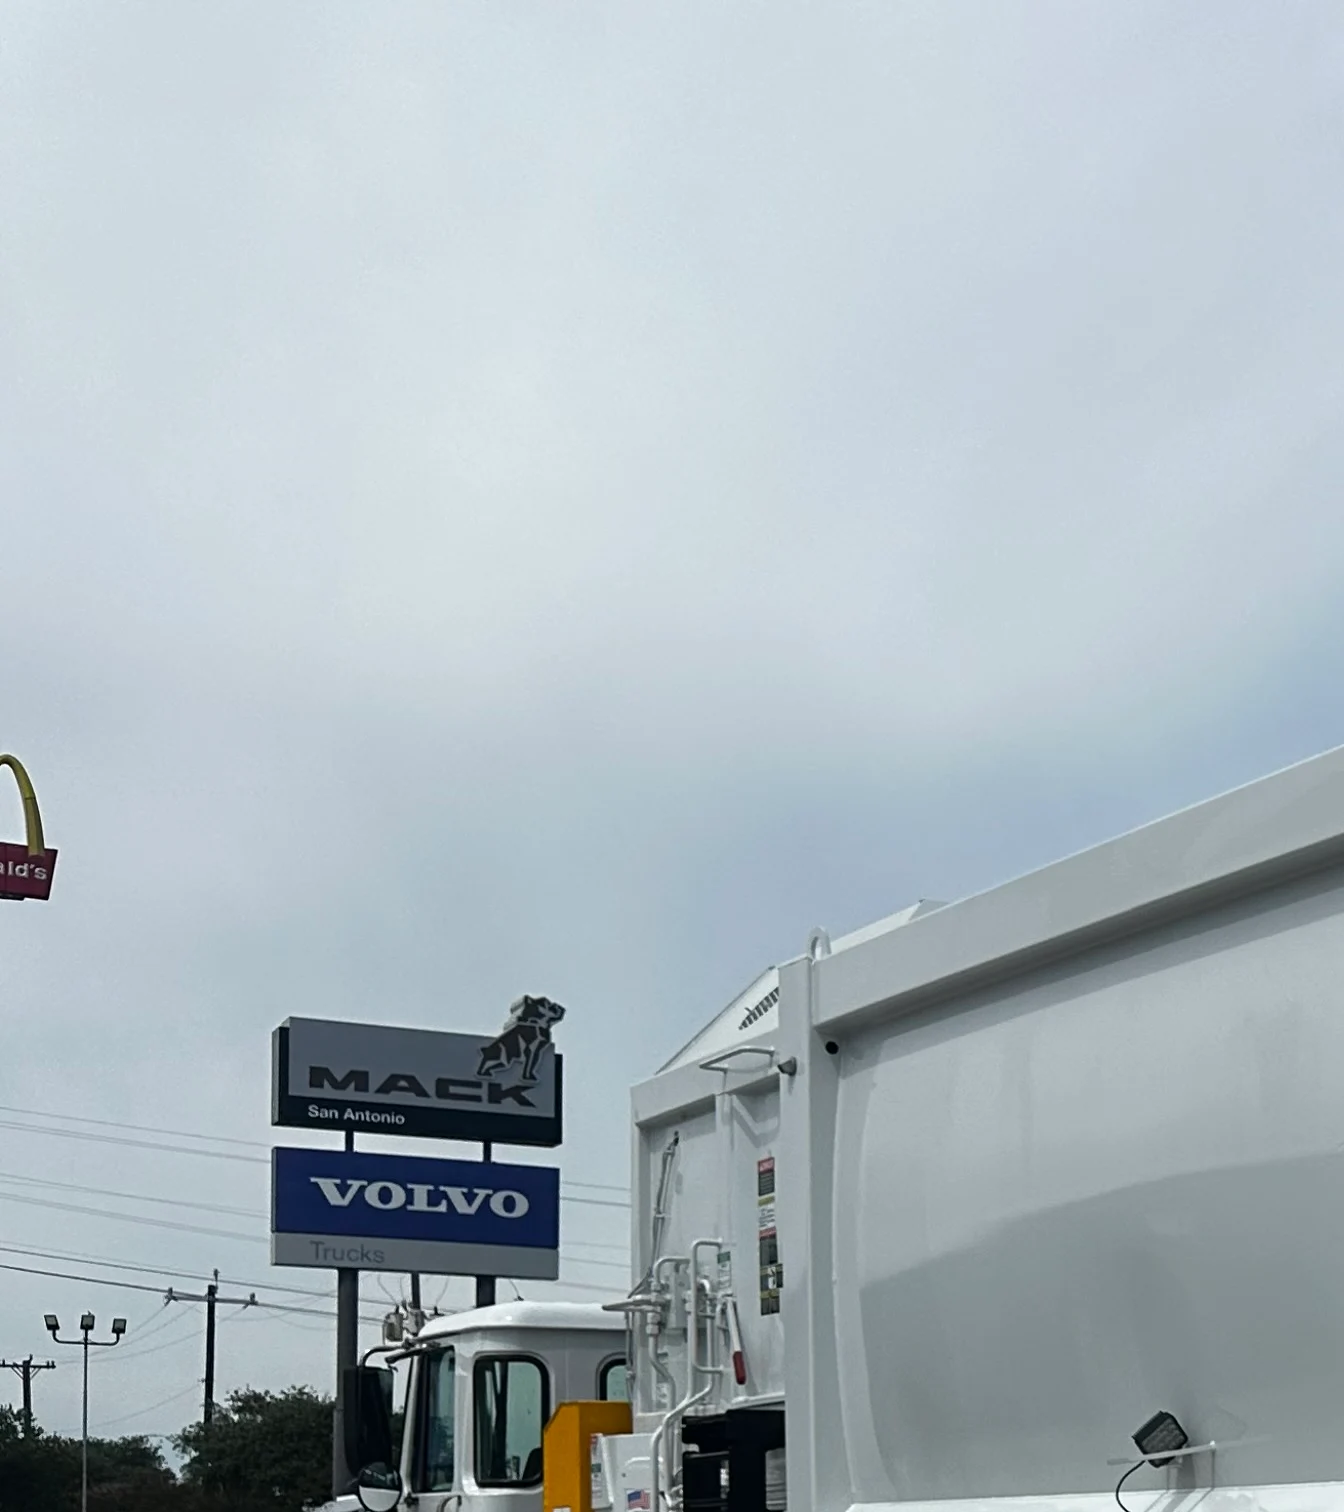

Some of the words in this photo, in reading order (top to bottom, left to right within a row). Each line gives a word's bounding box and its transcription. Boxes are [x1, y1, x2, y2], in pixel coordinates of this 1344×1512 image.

[308, 1065, 537, 1109] MACK
[307, 1104, 339, 1120] San
[343, 1107, 406, 1125] Antonio
[310, 1176, 530, 1219] VOLVO
[309, 1240, 386, 1264] Trucks
